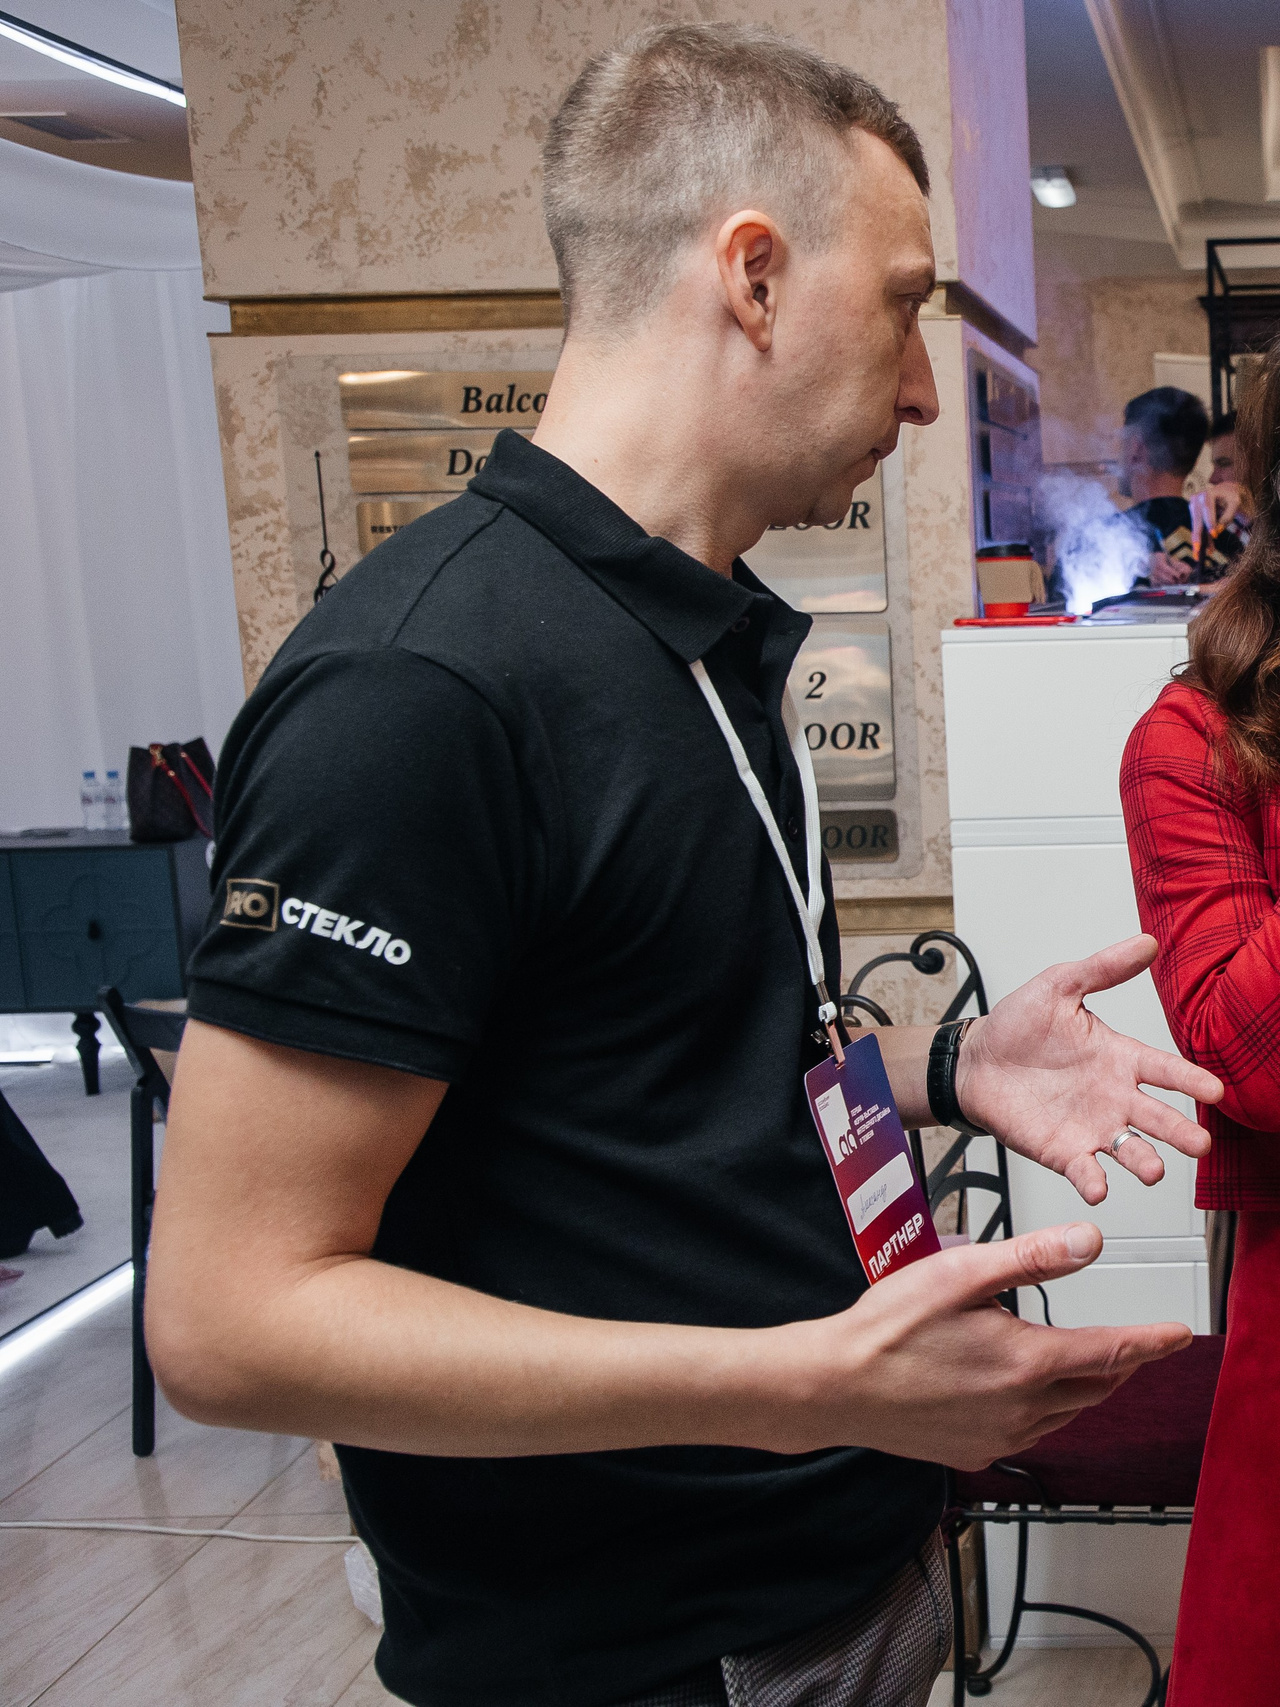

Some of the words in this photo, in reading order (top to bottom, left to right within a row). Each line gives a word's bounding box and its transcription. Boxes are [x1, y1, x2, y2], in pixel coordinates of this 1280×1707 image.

[805, 671, 827, 700] 2
[281, 897, 412, 965] СТЕКЛО
[868, 1213, 924, 1280] ПАРТНЕР
